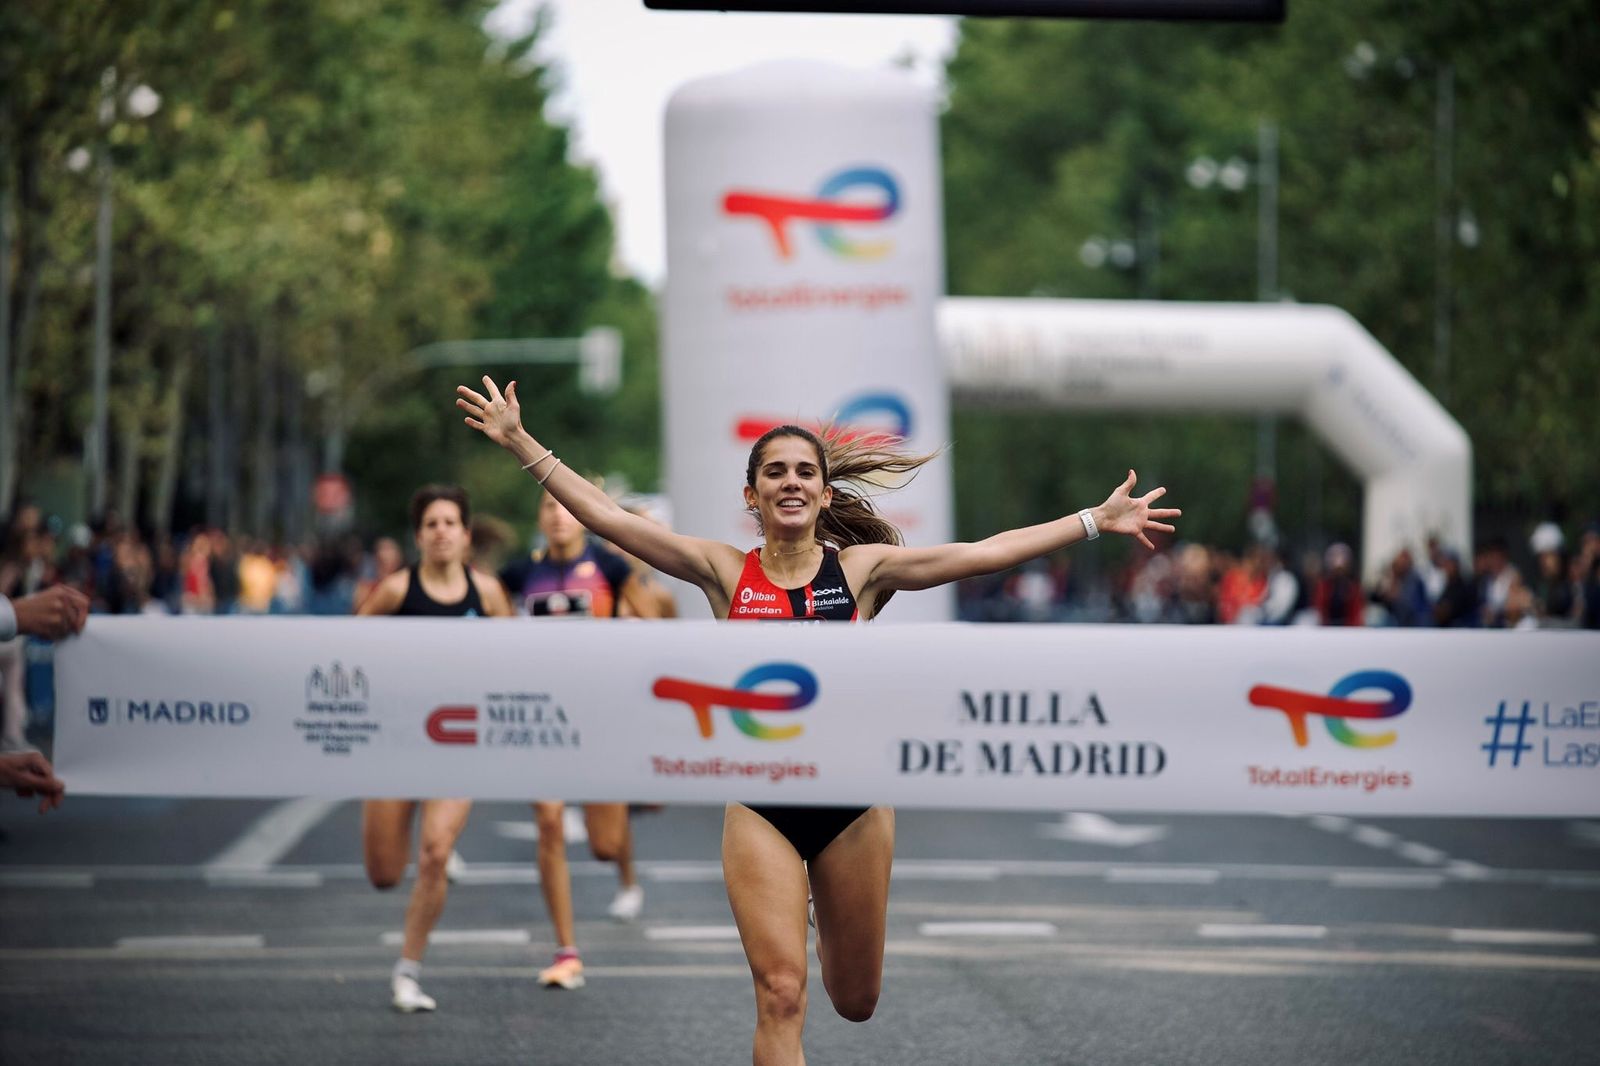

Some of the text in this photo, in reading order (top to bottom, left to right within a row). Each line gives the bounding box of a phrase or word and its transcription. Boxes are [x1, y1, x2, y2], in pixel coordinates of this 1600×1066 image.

[741, 587, 776, 604] Bilbao
[128, 700, 251, 725] MADRID
[959, 690, 1109, 726] MILLA
[1543, 701, 1600, 729] LaE
[898, 739, 1167, 778] DE MADRID
[1543, 736, 1600, 767] Las
[651, 755, 818, 783] TotalEnergies
[1247, 766, 1413, 792] TotalEnergies
